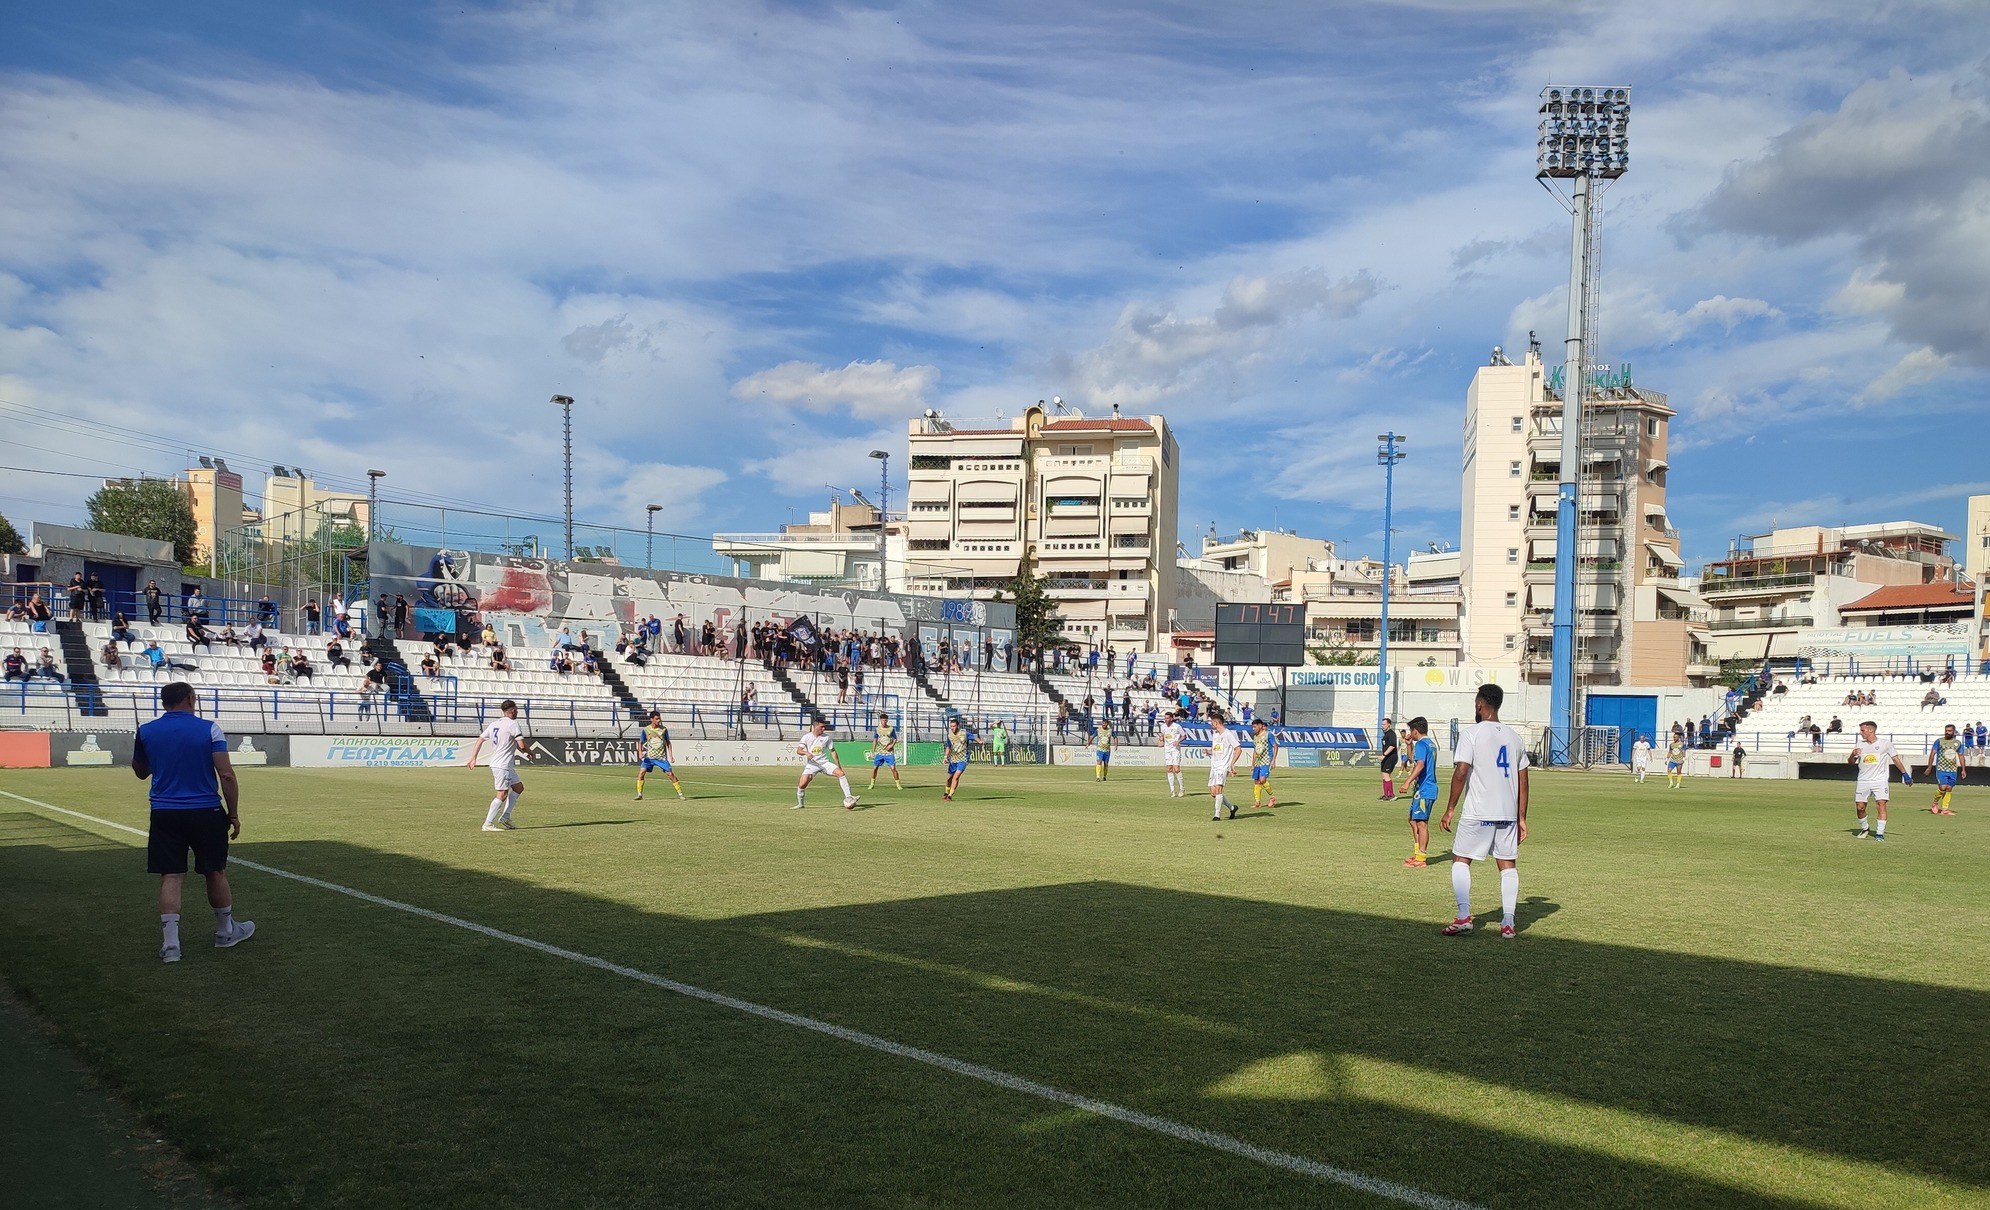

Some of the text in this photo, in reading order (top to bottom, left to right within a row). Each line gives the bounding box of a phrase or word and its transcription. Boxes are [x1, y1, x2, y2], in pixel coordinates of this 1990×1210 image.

[1268, 605, 1294, 623] 47
[1844, 629, 1913, 643] FUELS
[1290, 671, 1352, 686] TSIRICOTIS
[1448, 669, 1498, 686] WISH
[331, 737, 460, 747] ΤΑΠΗΤΟΚΑΘΑΡΙΣΤΗΡΙΑ
[493, 727, 500, 745] 3
[1282, 730, 1358, 745] ΝΕΑΠΟΛΗ
[326, 746, 459, 760] ΓΕΩΡΓΑΛΑΣ
[565, 750, 645, 763] ΚΥΡΑΝΝ
[1326, 750, 1340, 761] 200
[1496, 744, 1510, 778] 4
